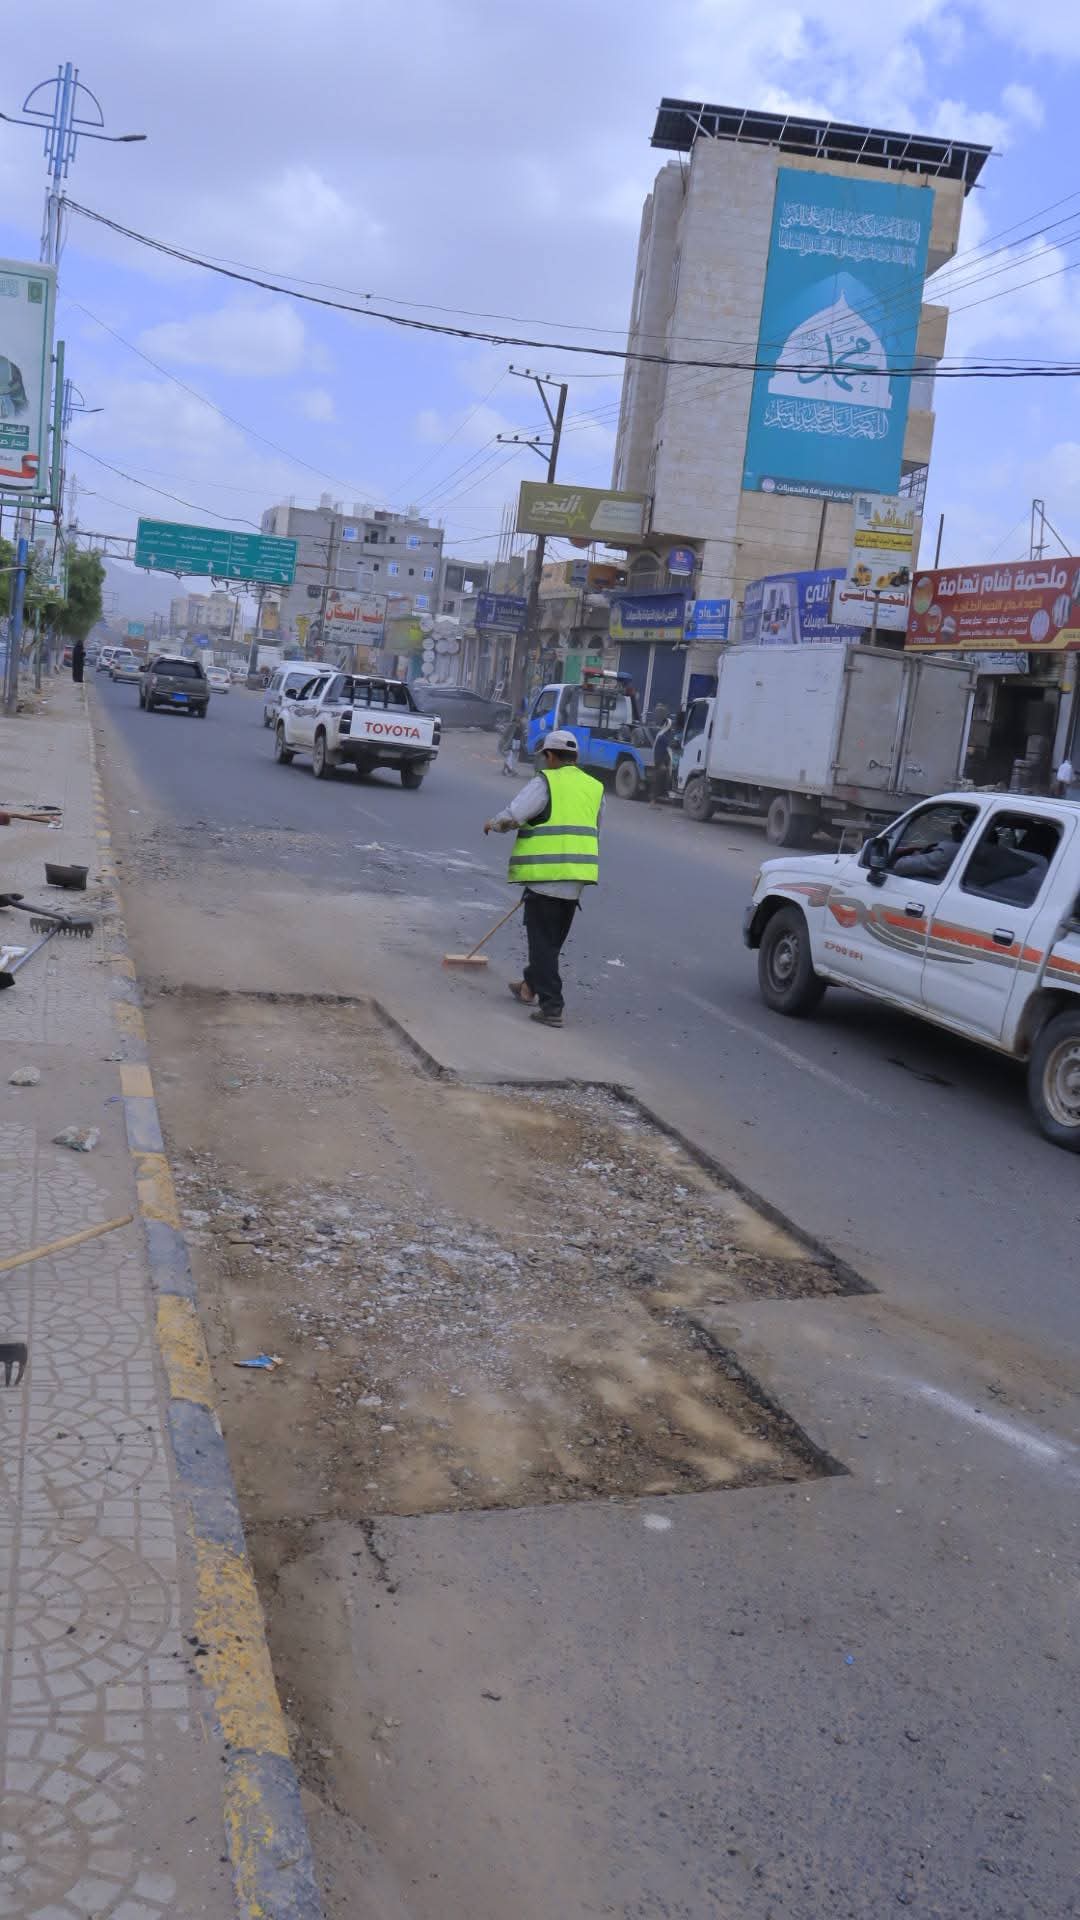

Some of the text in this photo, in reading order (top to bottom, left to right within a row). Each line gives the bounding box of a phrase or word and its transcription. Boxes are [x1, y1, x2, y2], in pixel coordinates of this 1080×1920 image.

[937, 565, 1068, 597] ملحمة شام تهامة
[364, 722, 420, 739] TOYOTA
